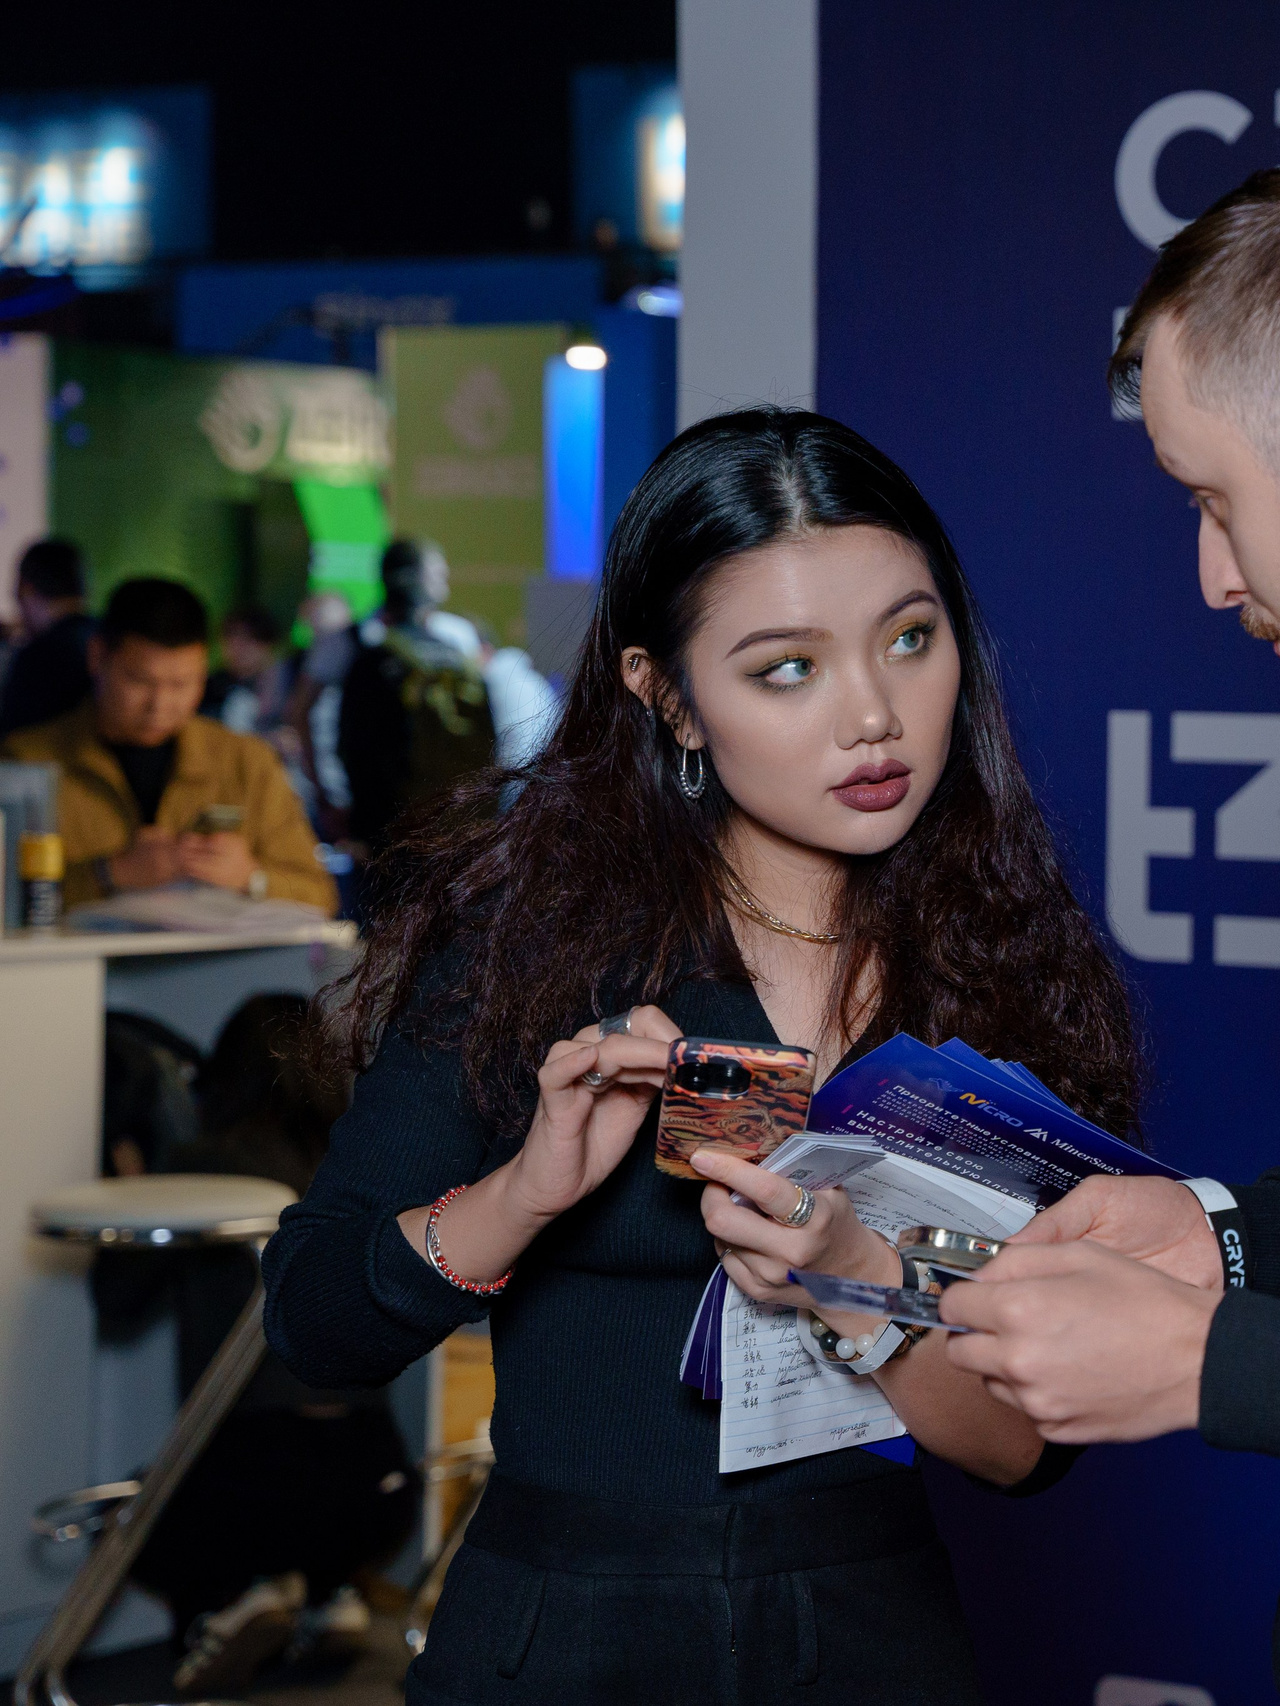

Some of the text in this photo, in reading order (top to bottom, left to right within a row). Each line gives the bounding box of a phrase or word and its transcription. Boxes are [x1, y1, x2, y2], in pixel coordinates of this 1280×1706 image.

[847, 1120, 981, 1180] вычислительную
[856, 1110, 943, 1151] Настройте
[946, 1151, 984, 1170] свою
[893, 1085, 990, 1135] Приоритетные
[990, 1135, 1048, 1165] условия
